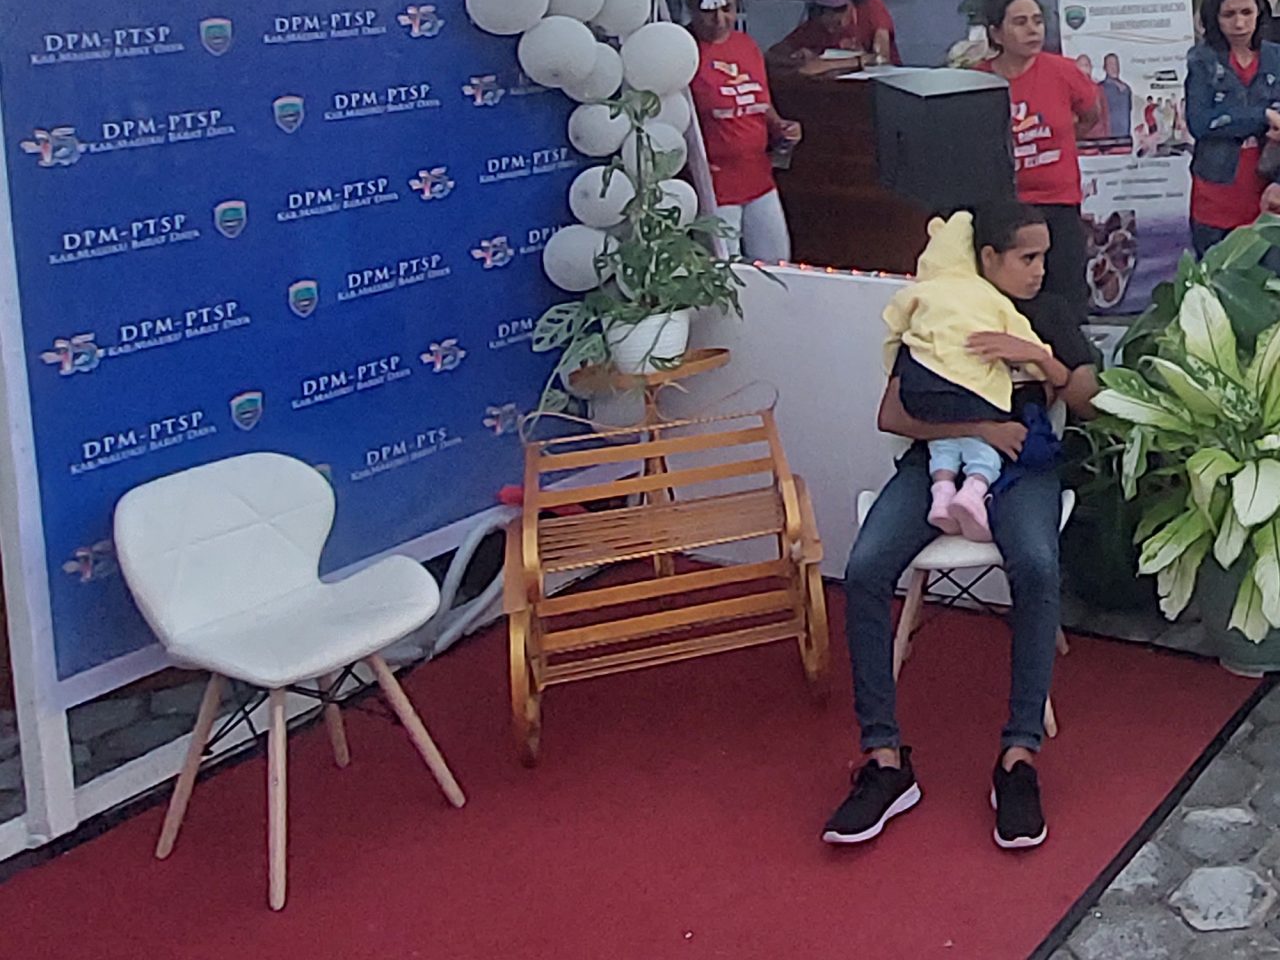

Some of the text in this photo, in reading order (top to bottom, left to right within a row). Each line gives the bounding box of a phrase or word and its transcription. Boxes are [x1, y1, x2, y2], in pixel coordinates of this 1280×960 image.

[275, 10, 377, 32] DPM-PTSP
[44, 26, 171, 51] DPM-PTSP
[334, 84, 430, 109] DPM-PTSP
[103, 109, 222, 139] DPM-PTSP
[289, 178, 388, 209] DPM-PTSP
[63, 214, 187, 250] DPM-PTSP
[348, 254, 442, 289] DPM-PTSP
[120, 301, 239, 342] DPM-PTSP
[303, 355, 401, 396] DPM-PTSP
[82, 411, 204, 459] DPM-PTSP
